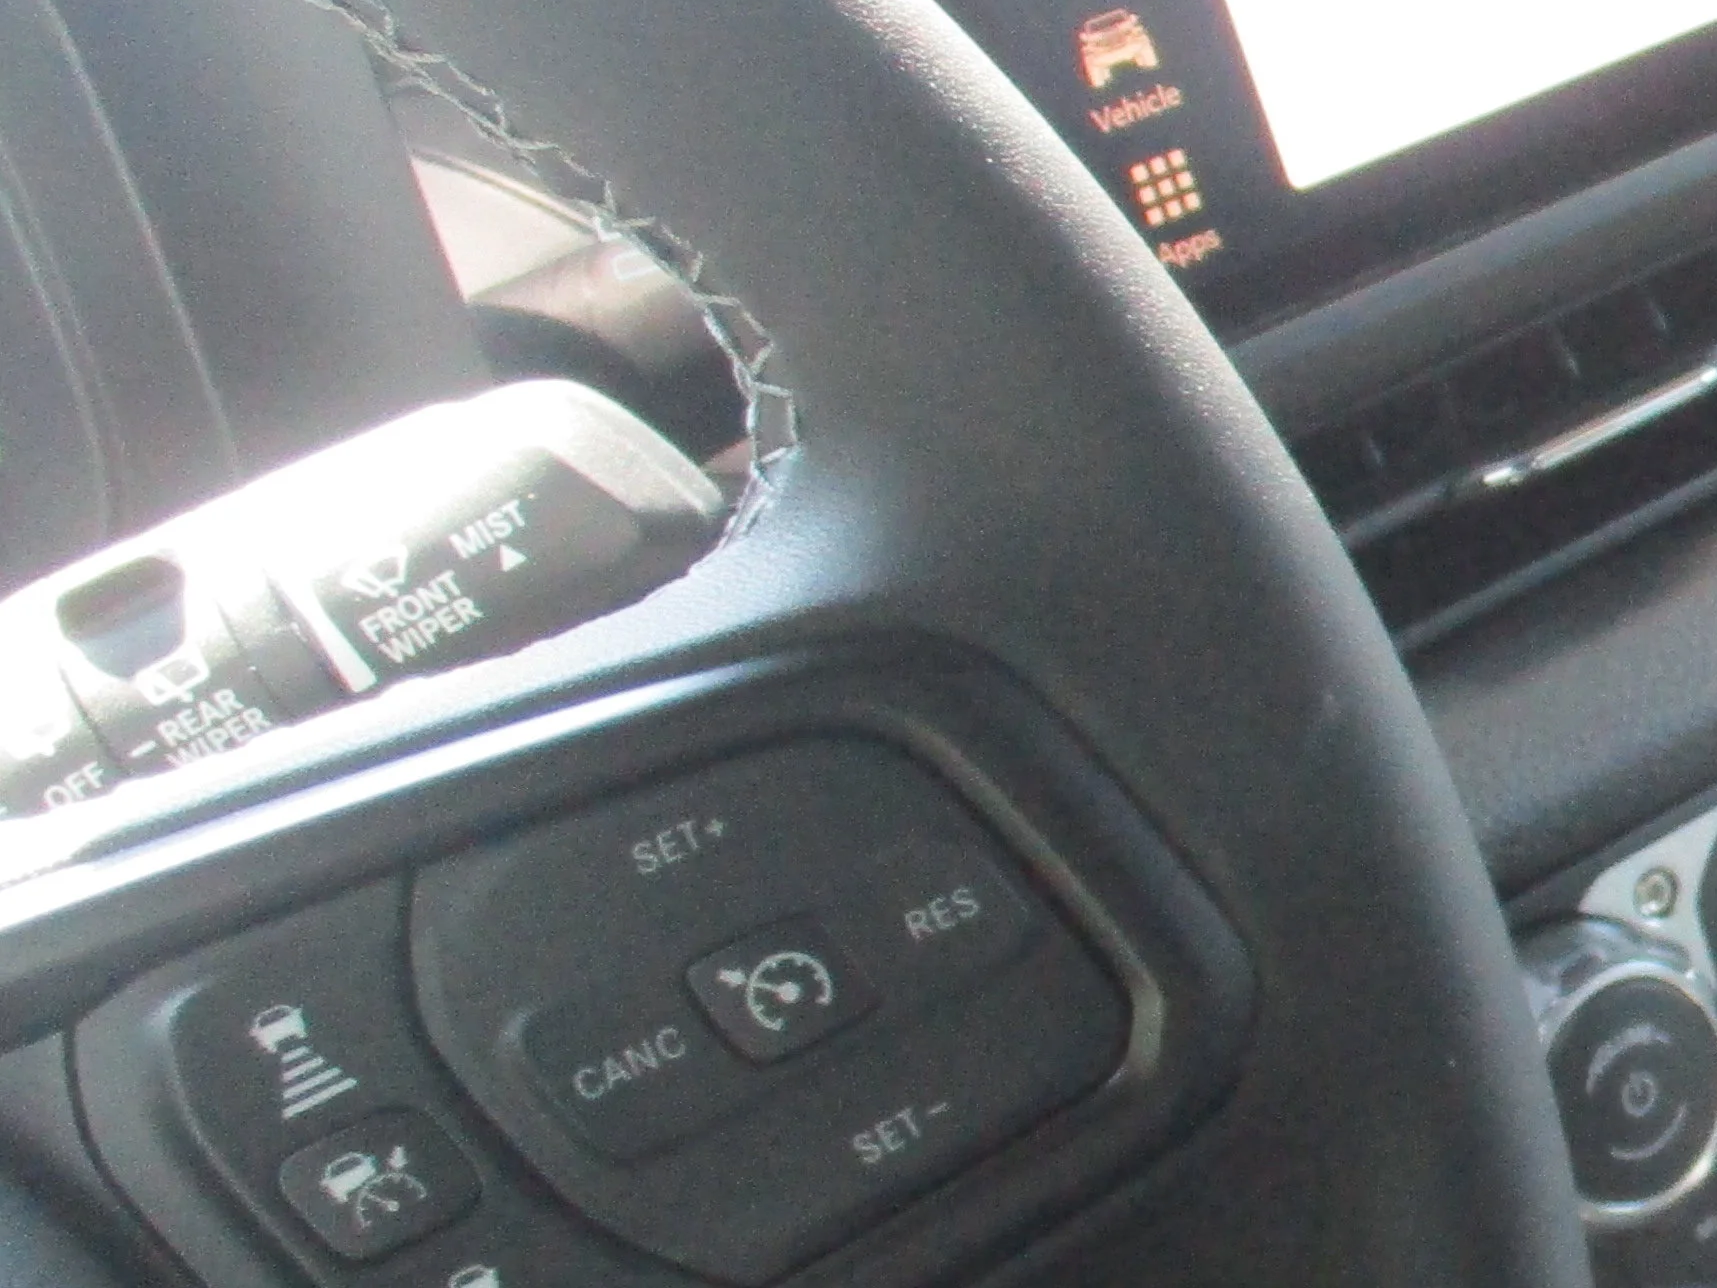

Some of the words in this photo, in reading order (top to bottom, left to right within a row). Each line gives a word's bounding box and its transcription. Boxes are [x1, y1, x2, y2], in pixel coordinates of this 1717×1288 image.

[1087, 84, 1182, 133] Vehicle
[1157, 229, 1224, 268] Apps
[448, 499, 526, 560] MIST
[358, 570, 462, 644] FRONT
[377, 596, 485, 664] WIPER
[157, 688, 245, 748] REAR
[165, 707, 272, 769] WIPER
[43, 760, 105, 810] OFF
[904, 887, 980, 943] RES
[572, 1026, 687, 1101] CANC
